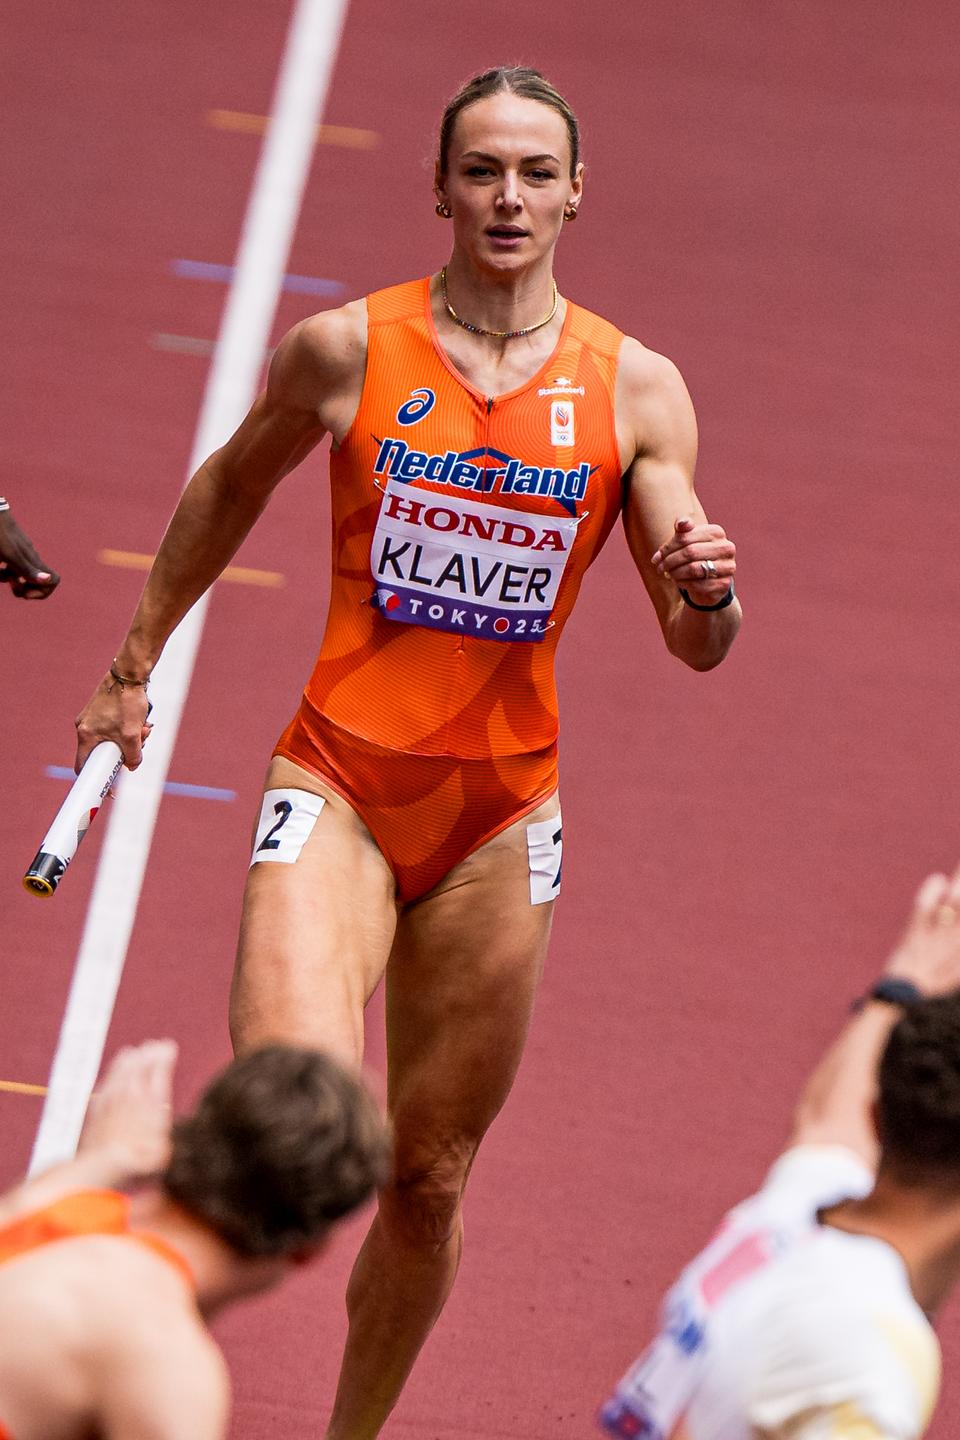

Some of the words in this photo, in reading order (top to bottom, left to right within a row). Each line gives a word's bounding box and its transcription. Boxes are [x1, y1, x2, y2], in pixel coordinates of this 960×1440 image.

[384, 495, 567, 552] HONDA
[377, 537, 552, 603] KLAVER
[256, 800, 293, 853] 2
